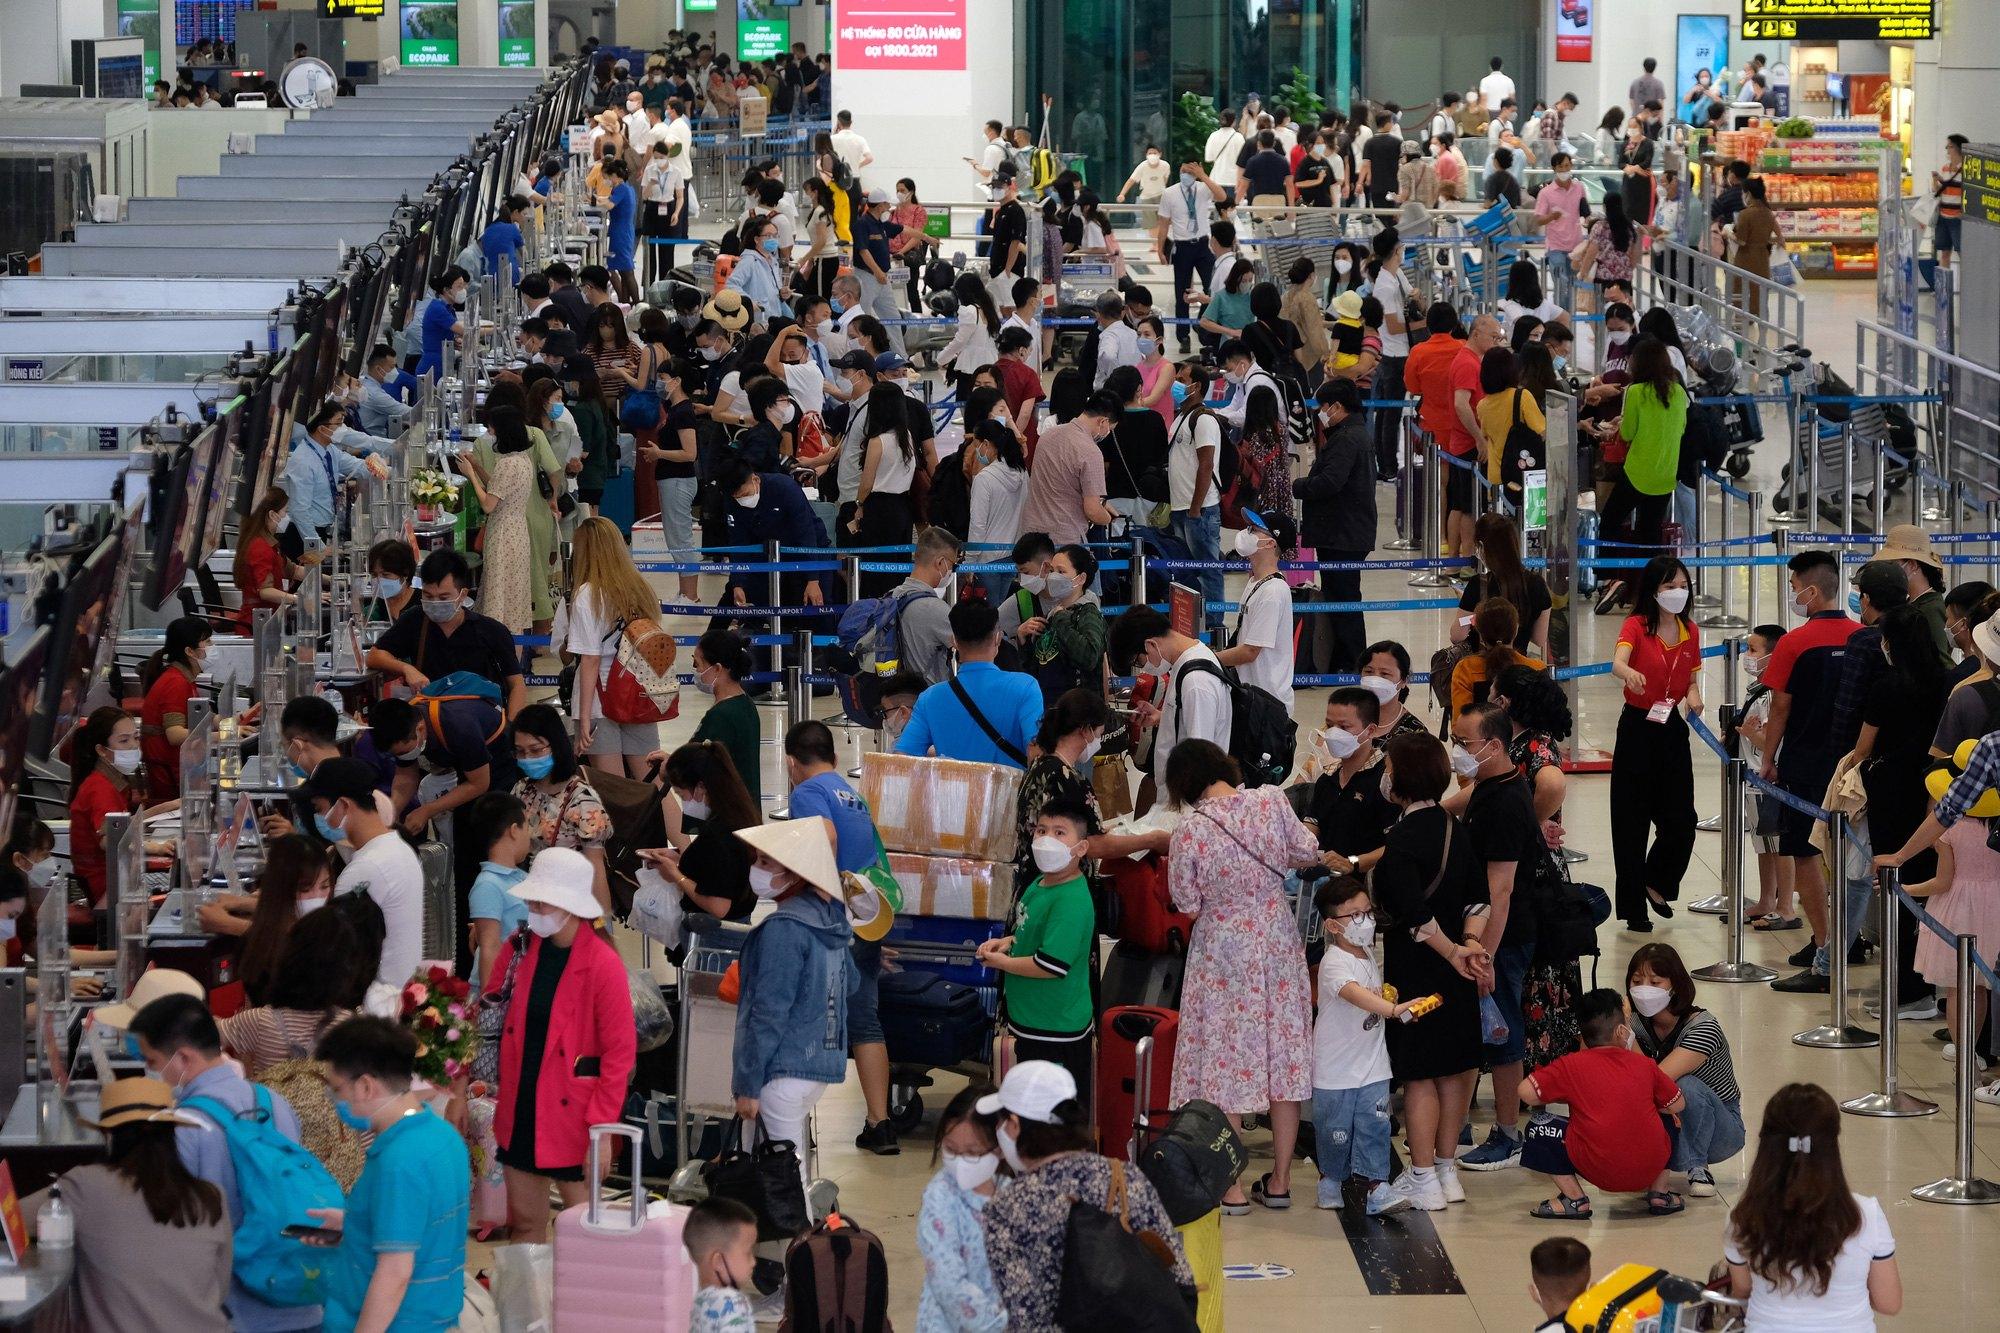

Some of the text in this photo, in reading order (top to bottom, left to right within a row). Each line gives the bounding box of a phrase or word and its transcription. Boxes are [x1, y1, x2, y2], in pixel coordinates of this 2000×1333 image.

[1922, 19, 1930, 28] A
[841, 27, 855, 40] HỆ
[855, 26, 886, 39] THỐNG
[903, 25, 929, 39] CỬA
[929, 26, 962, 39] HÀNG
[1879, 28, 1930, 37] Arrival Hall A
[882, 45, 938, 57] 1800.2021
[408, 54, 450, 63] ECOPARK
[504, 53, 530, 62] ECOPARK
[9, 365, 28, 380] HÒNG
[1166, 560, 1184, 568] CẢNG
[1184, 560, 1203, 568] HÀNG
[1226, 561, 1243, 569] QUỐC
[1725, 556, 1757, 564] AIRPORT
[1314, 603, 1371, 611] INTERNATIONAL
[1371, 602, 1400, 610] AIRPORT
[531, 676, 544, 684] NỘI
[546, 676, 558, 684] BÀI
[1295, 676, 1309, 684] NỘI
[1309, 675, 1322, 683] BÀI
[1100, 723, 1127, 743] upreme
[1333, 1131, 1347, 1141] SAY
